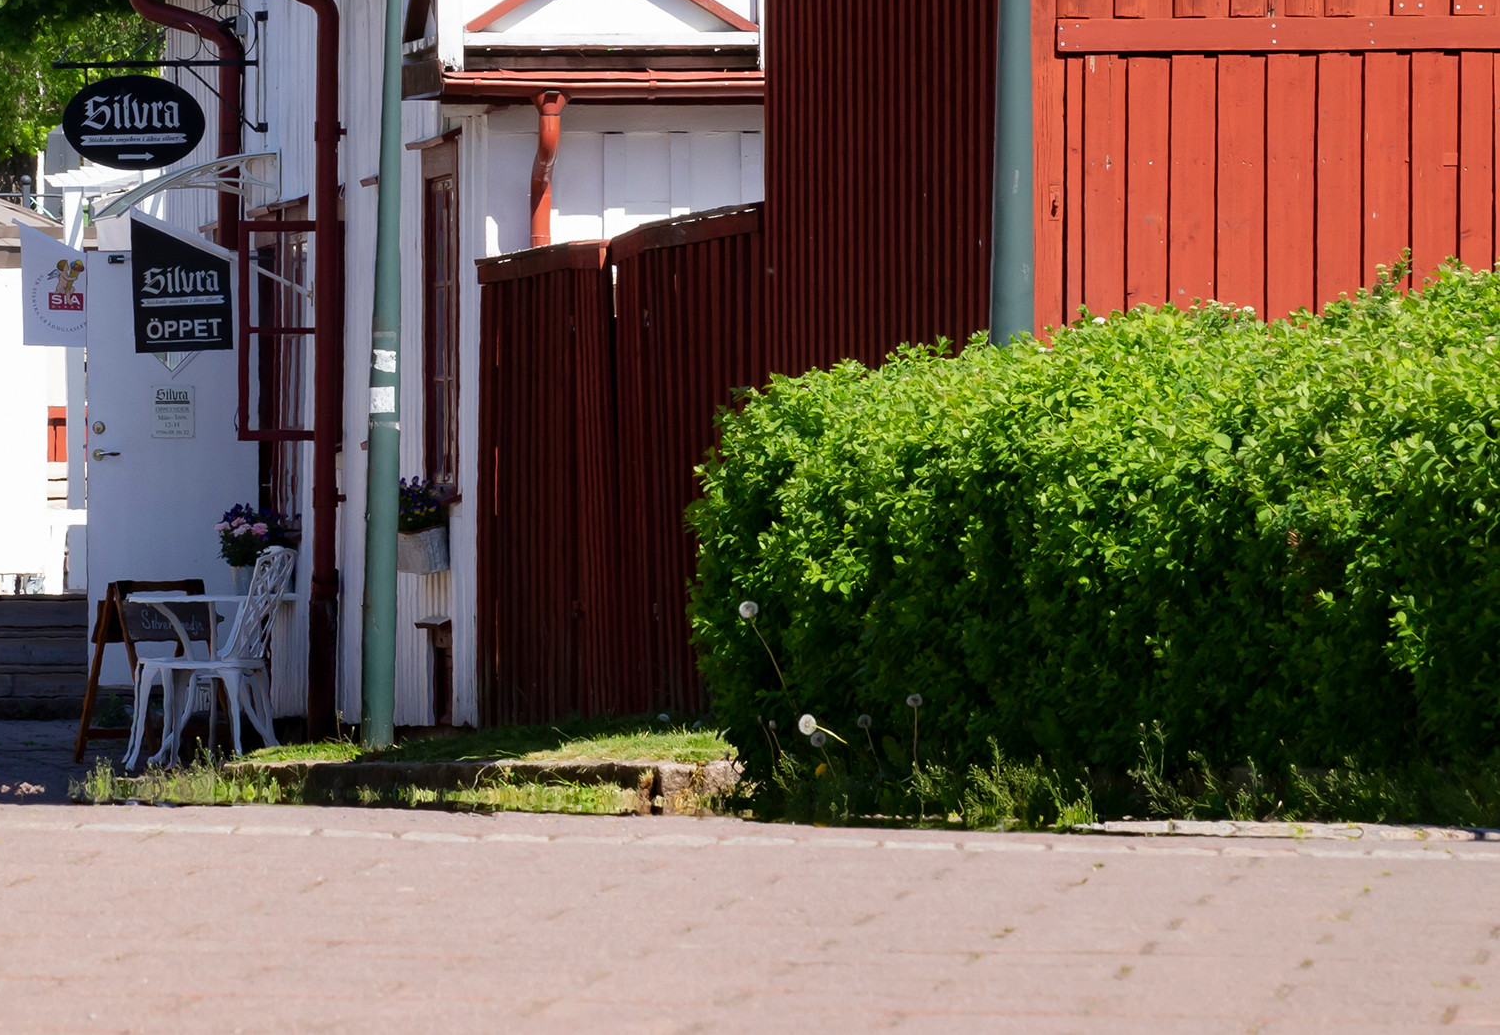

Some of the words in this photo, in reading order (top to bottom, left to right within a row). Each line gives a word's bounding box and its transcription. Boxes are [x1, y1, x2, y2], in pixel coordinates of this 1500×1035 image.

[81, 93, 180, 130] Silvra
[141, 265, 219, 295] Silvra
[51, 294, 81, 305] SIA
[146, 318, 222, 339] ÖPPET
[156, 388, 188, 400] Silvra
[141, 608, 204, 636] Silveredja
